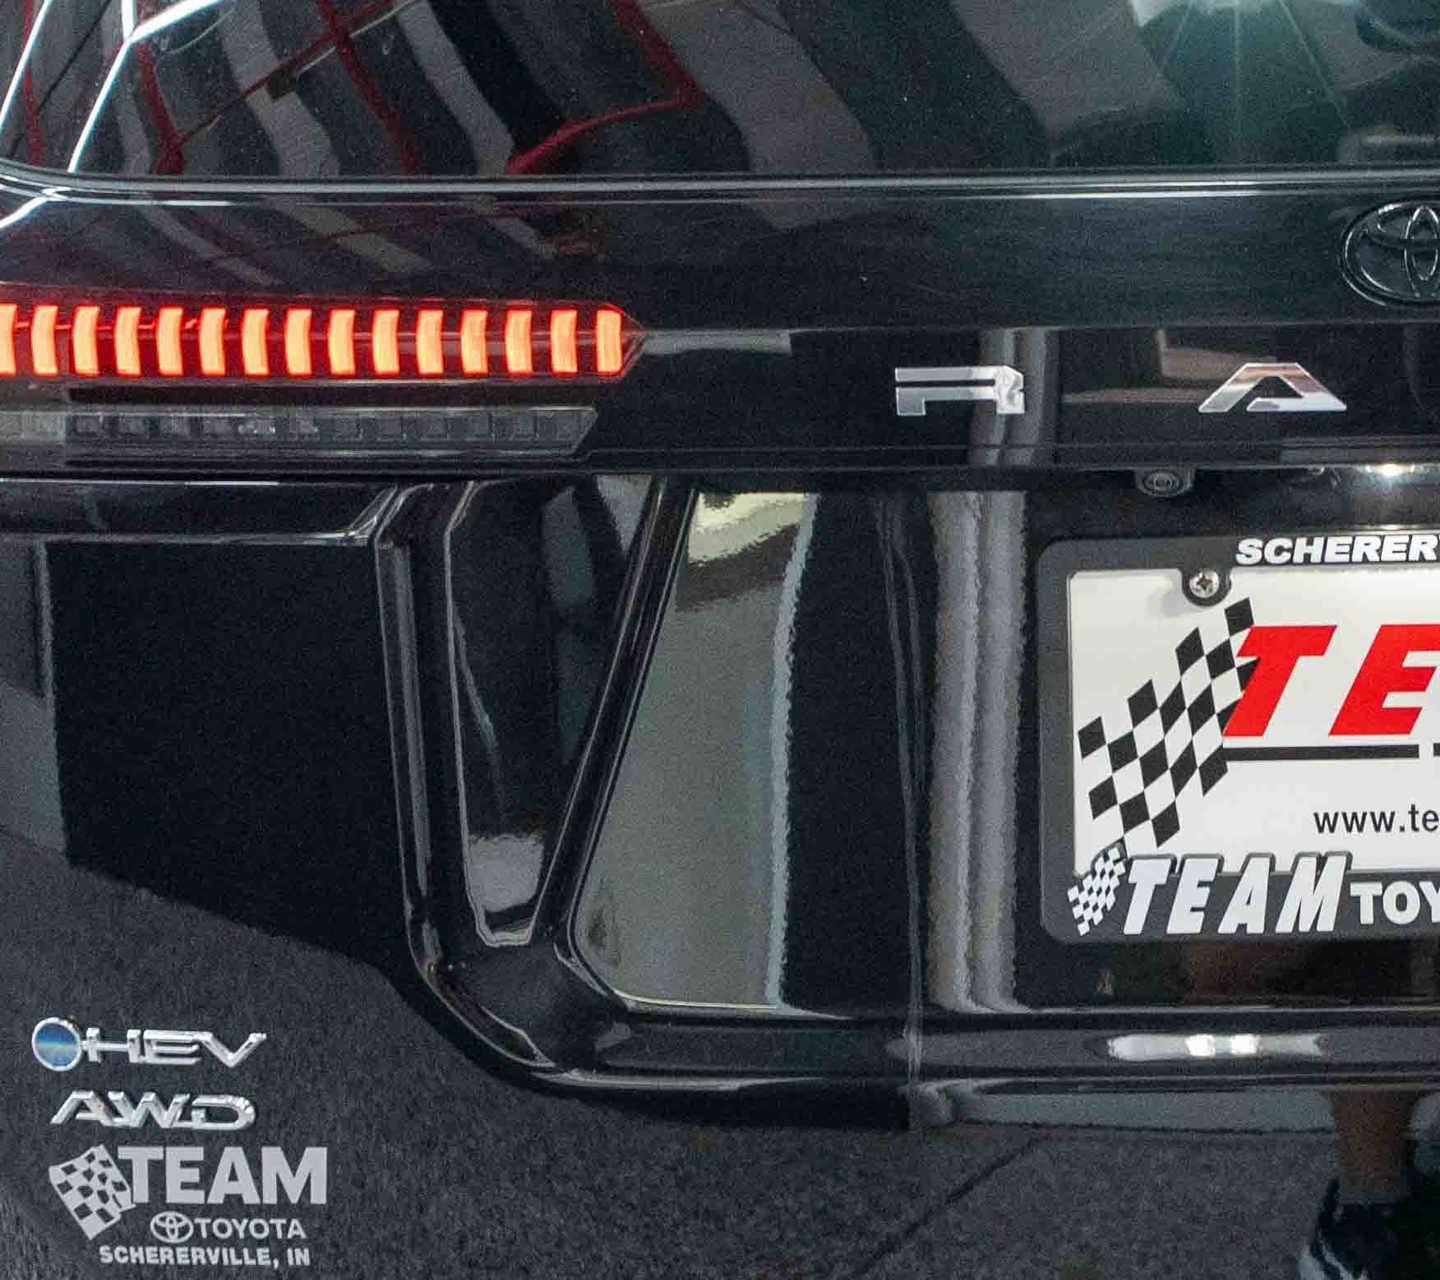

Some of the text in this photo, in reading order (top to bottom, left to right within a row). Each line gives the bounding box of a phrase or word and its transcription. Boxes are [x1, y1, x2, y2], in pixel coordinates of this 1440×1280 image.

[1123, 854, 1350, 935] TEAM
[82, 1027, 267, 1068] HEV
[50, 1091, 257, 1131] AWD
[117, 1146, 328, 1205] TEAM
[194, 1218, 307, 1240] TOYOTA
[99, 1245, 311, 1269] SCHERERVILLE, IN
